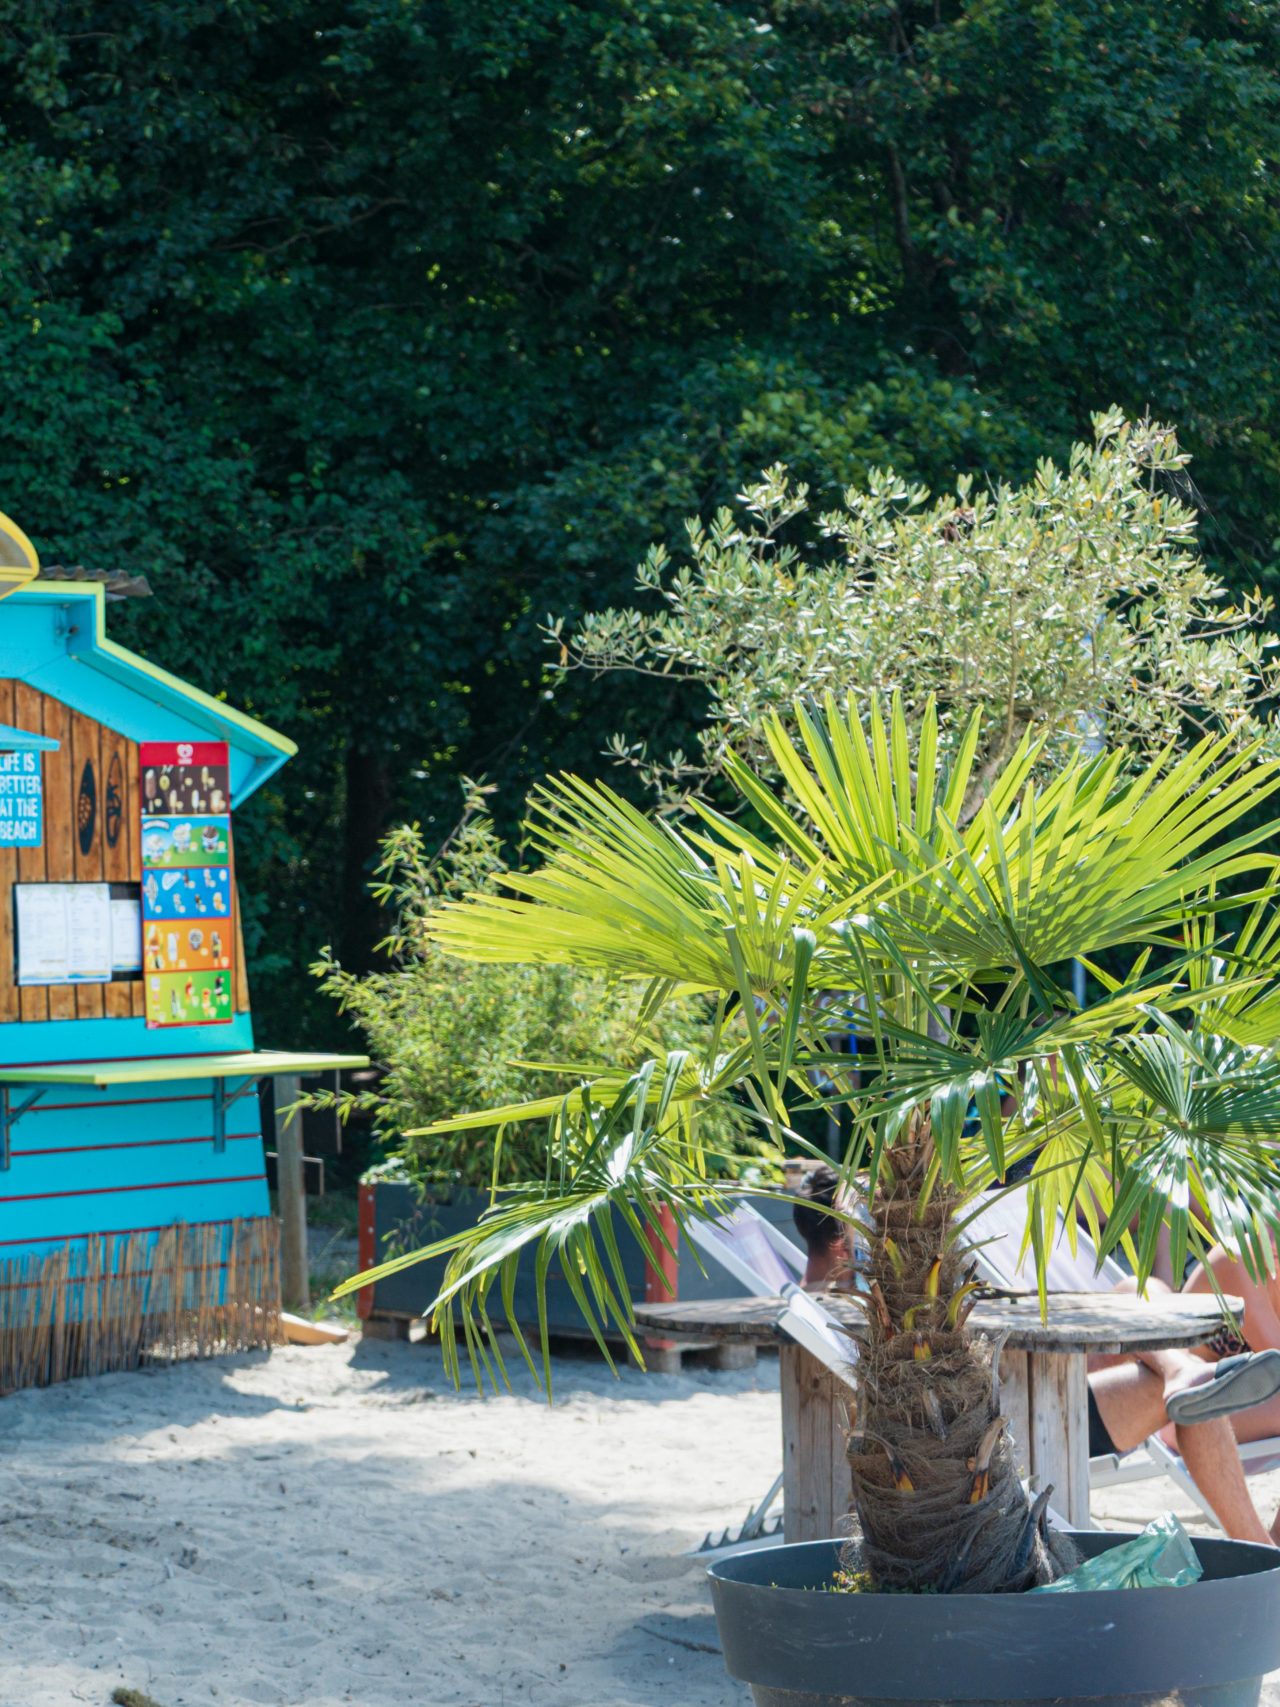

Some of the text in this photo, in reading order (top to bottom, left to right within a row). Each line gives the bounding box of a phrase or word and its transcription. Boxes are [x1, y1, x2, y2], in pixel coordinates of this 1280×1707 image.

[23, 752, 35, 772] IS
[16, 798, 38, 817] THE
[0, 821, 37, 840] BEACH
